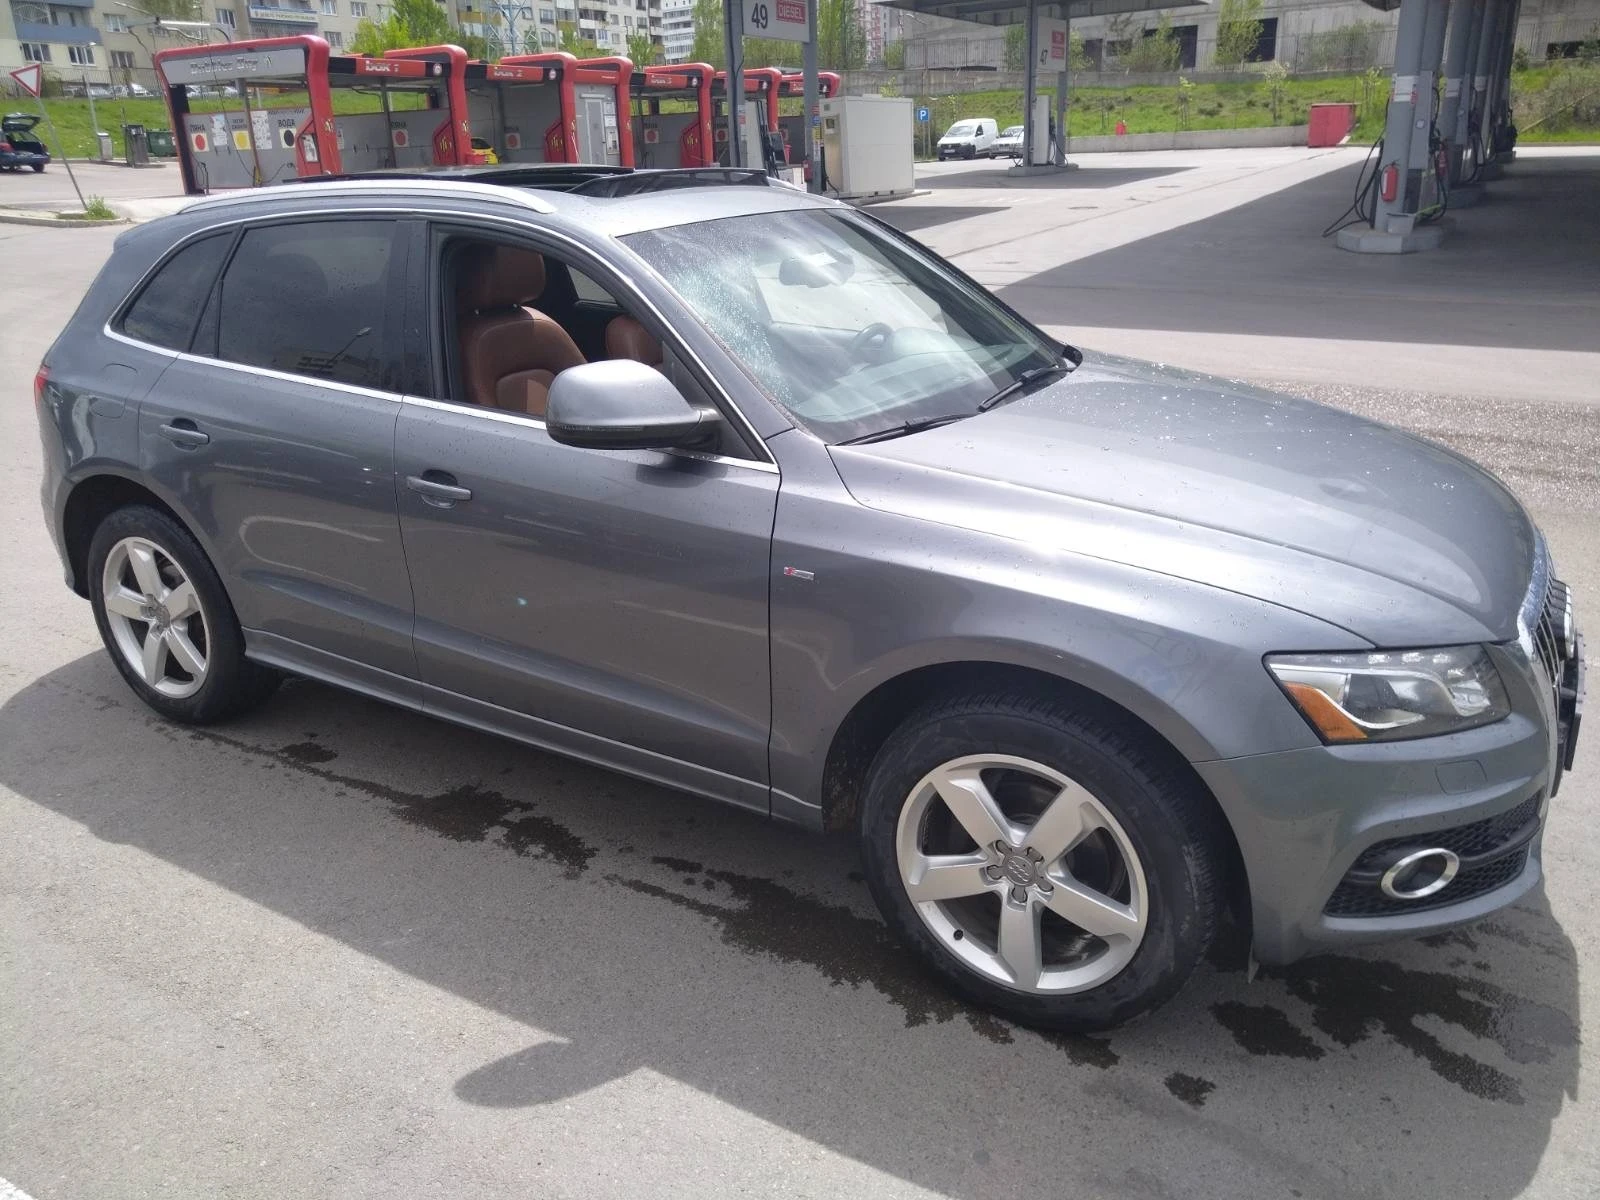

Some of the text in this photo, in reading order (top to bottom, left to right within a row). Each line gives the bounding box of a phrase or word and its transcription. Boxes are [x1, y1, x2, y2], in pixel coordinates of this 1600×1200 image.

[751, 3, 768, 29] 49
[778, 5, 803, 19] DIESEL
[1040, 47, 1048, 65] 47
[920, 109, 927, 121] P
[278, 118, 296, 129] ВОДА
